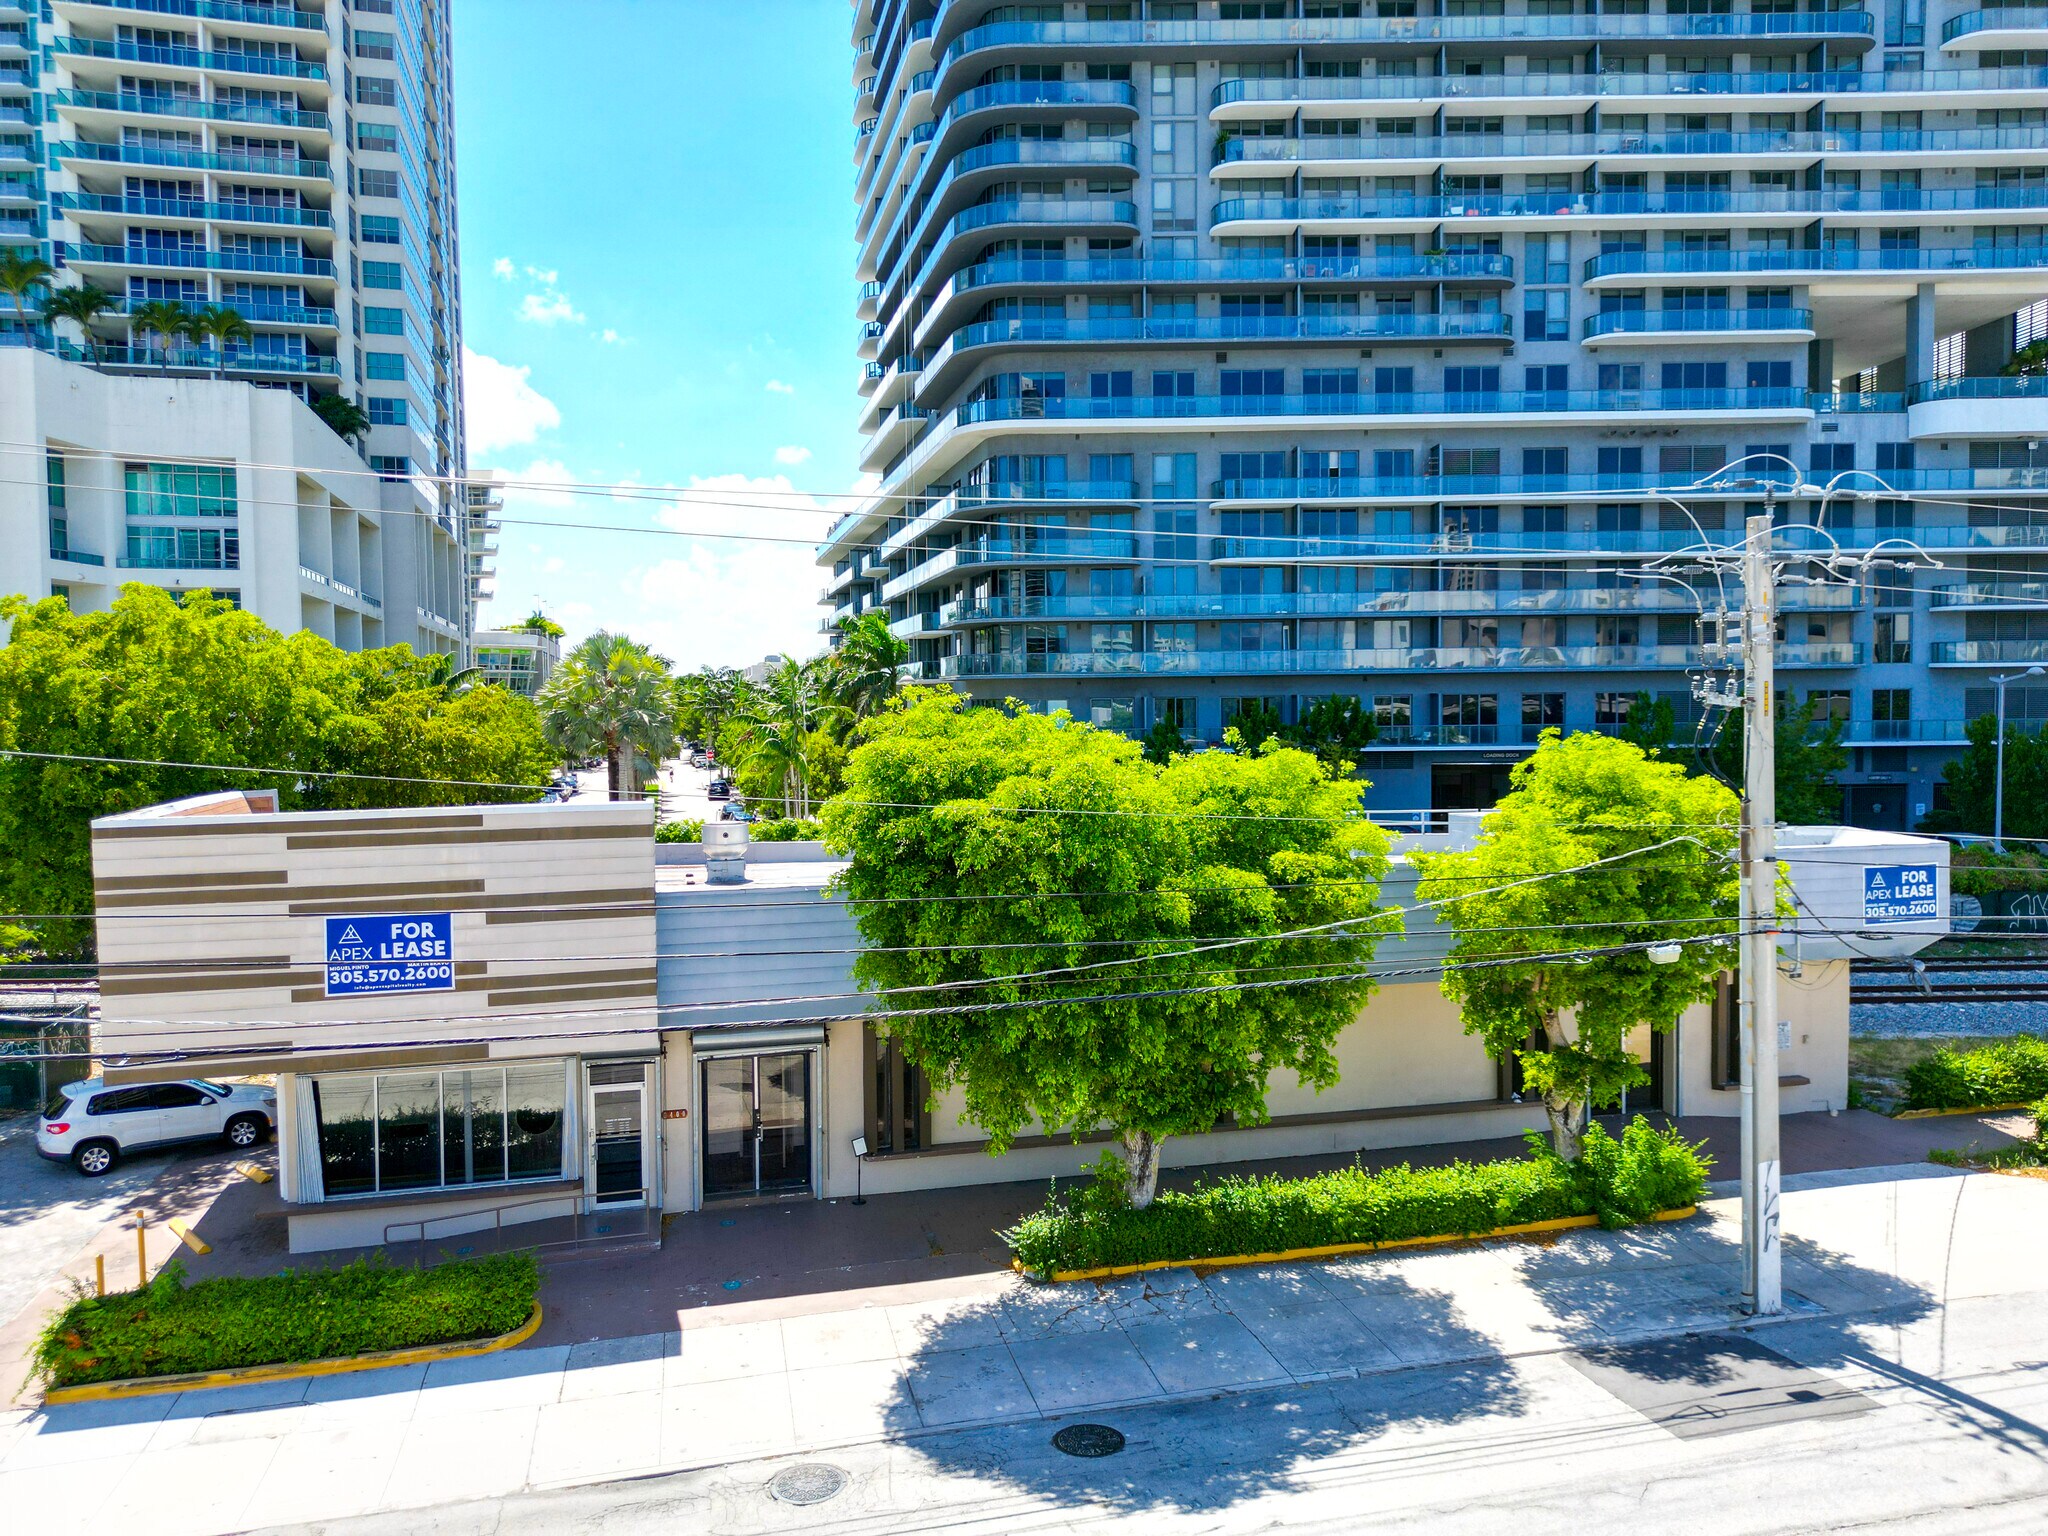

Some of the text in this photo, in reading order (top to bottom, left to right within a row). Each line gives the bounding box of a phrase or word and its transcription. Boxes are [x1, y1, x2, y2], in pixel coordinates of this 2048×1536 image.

[1901, 870, 1928, 884] FOR
[1865, 889, 1891, 900] APEX
[1895, 884, 1934, 898] LEASE
[1865, 903, 1936, 918] 305.570.2600
[391, 922, 436, 939] FOR
[329, 947, 373, 961] APEX
[381, 940, 446, 959] LEASE
[329, 966, 450, 985] 305.570.2600
